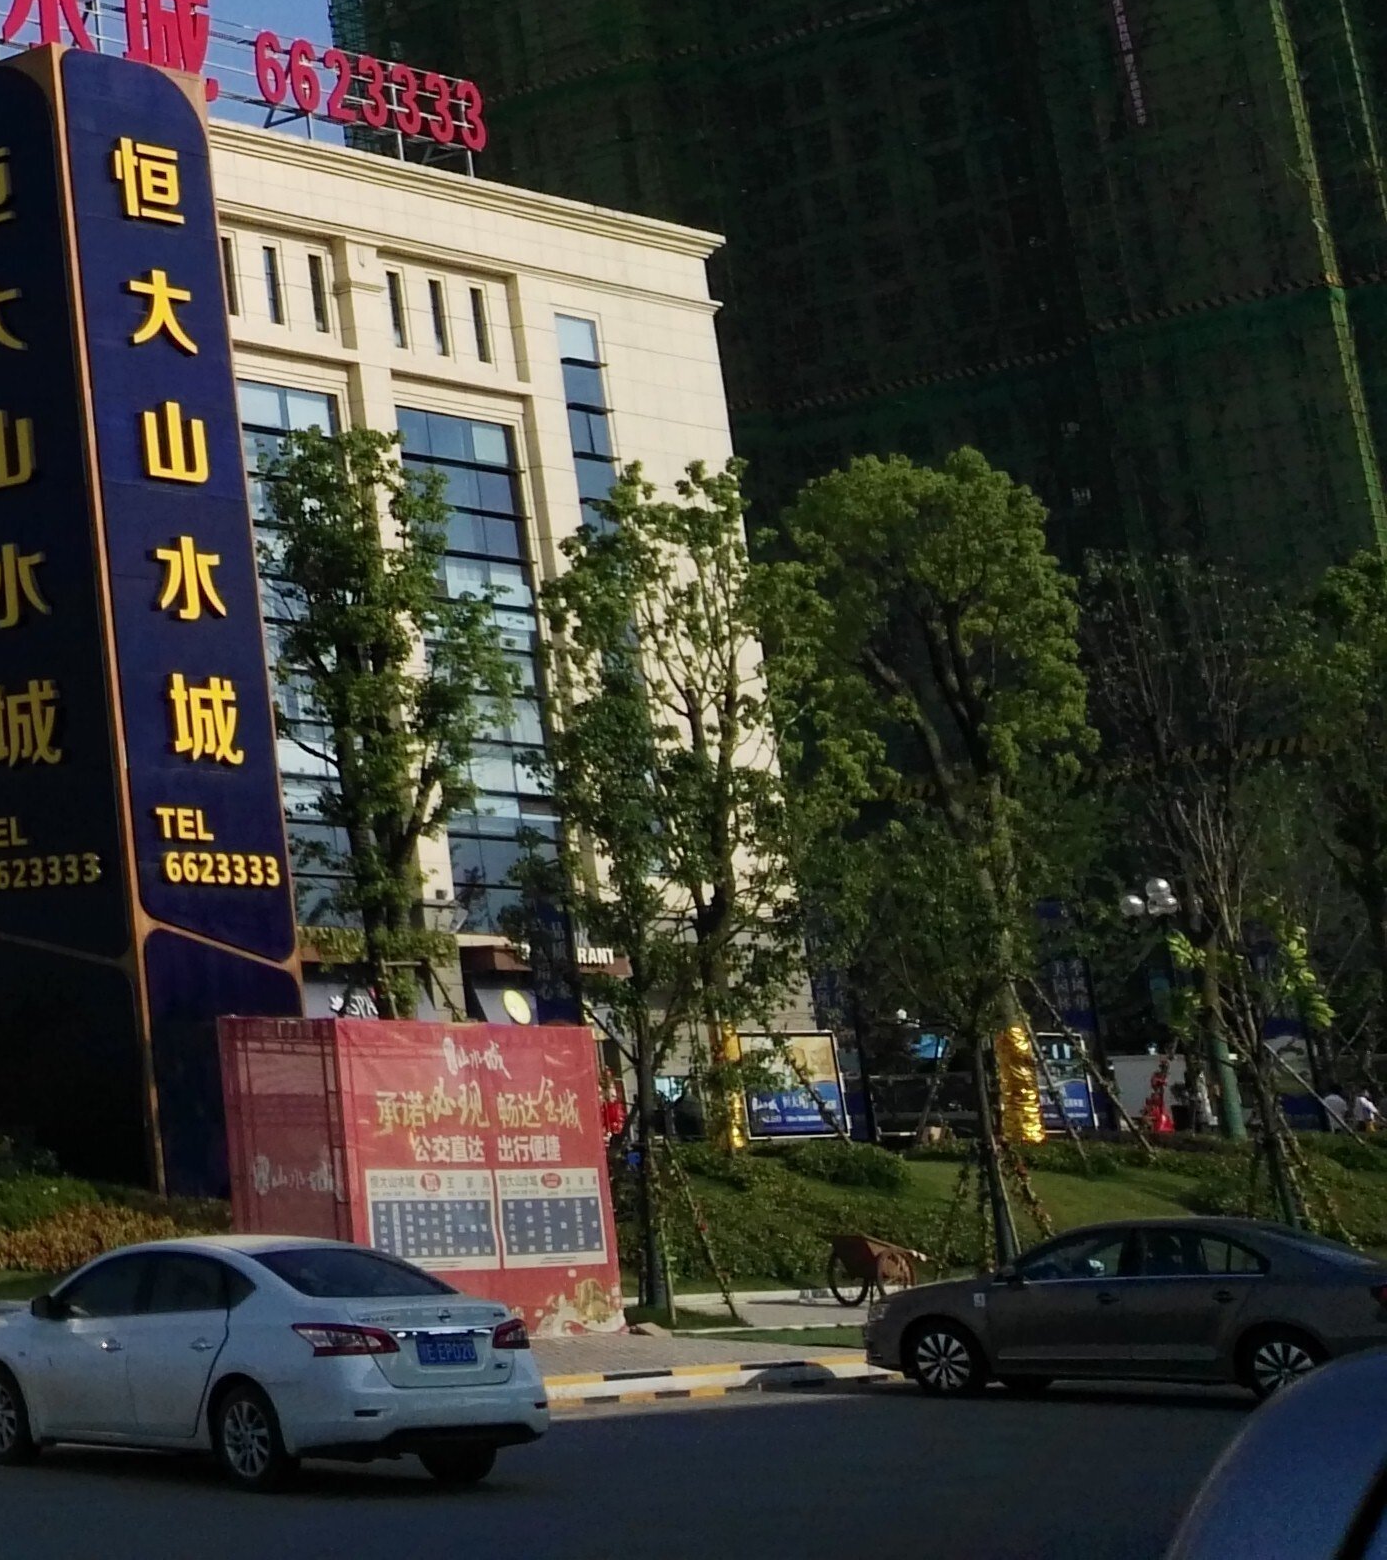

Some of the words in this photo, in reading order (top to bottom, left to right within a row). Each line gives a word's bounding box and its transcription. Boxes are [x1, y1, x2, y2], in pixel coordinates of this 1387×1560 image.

[254, 30, 488, 152] 6623333
[114, 137, 244, 766] 恒大山水城
[155, 807, 214, 841] TEL
[165, 851, 280, 887] 6623333
[497, 1075, 584, 1134] 畅达全城
[414, 1134, 486, 1162] 公交直达
[498, 1135, 562, 1162] 出行便捷
